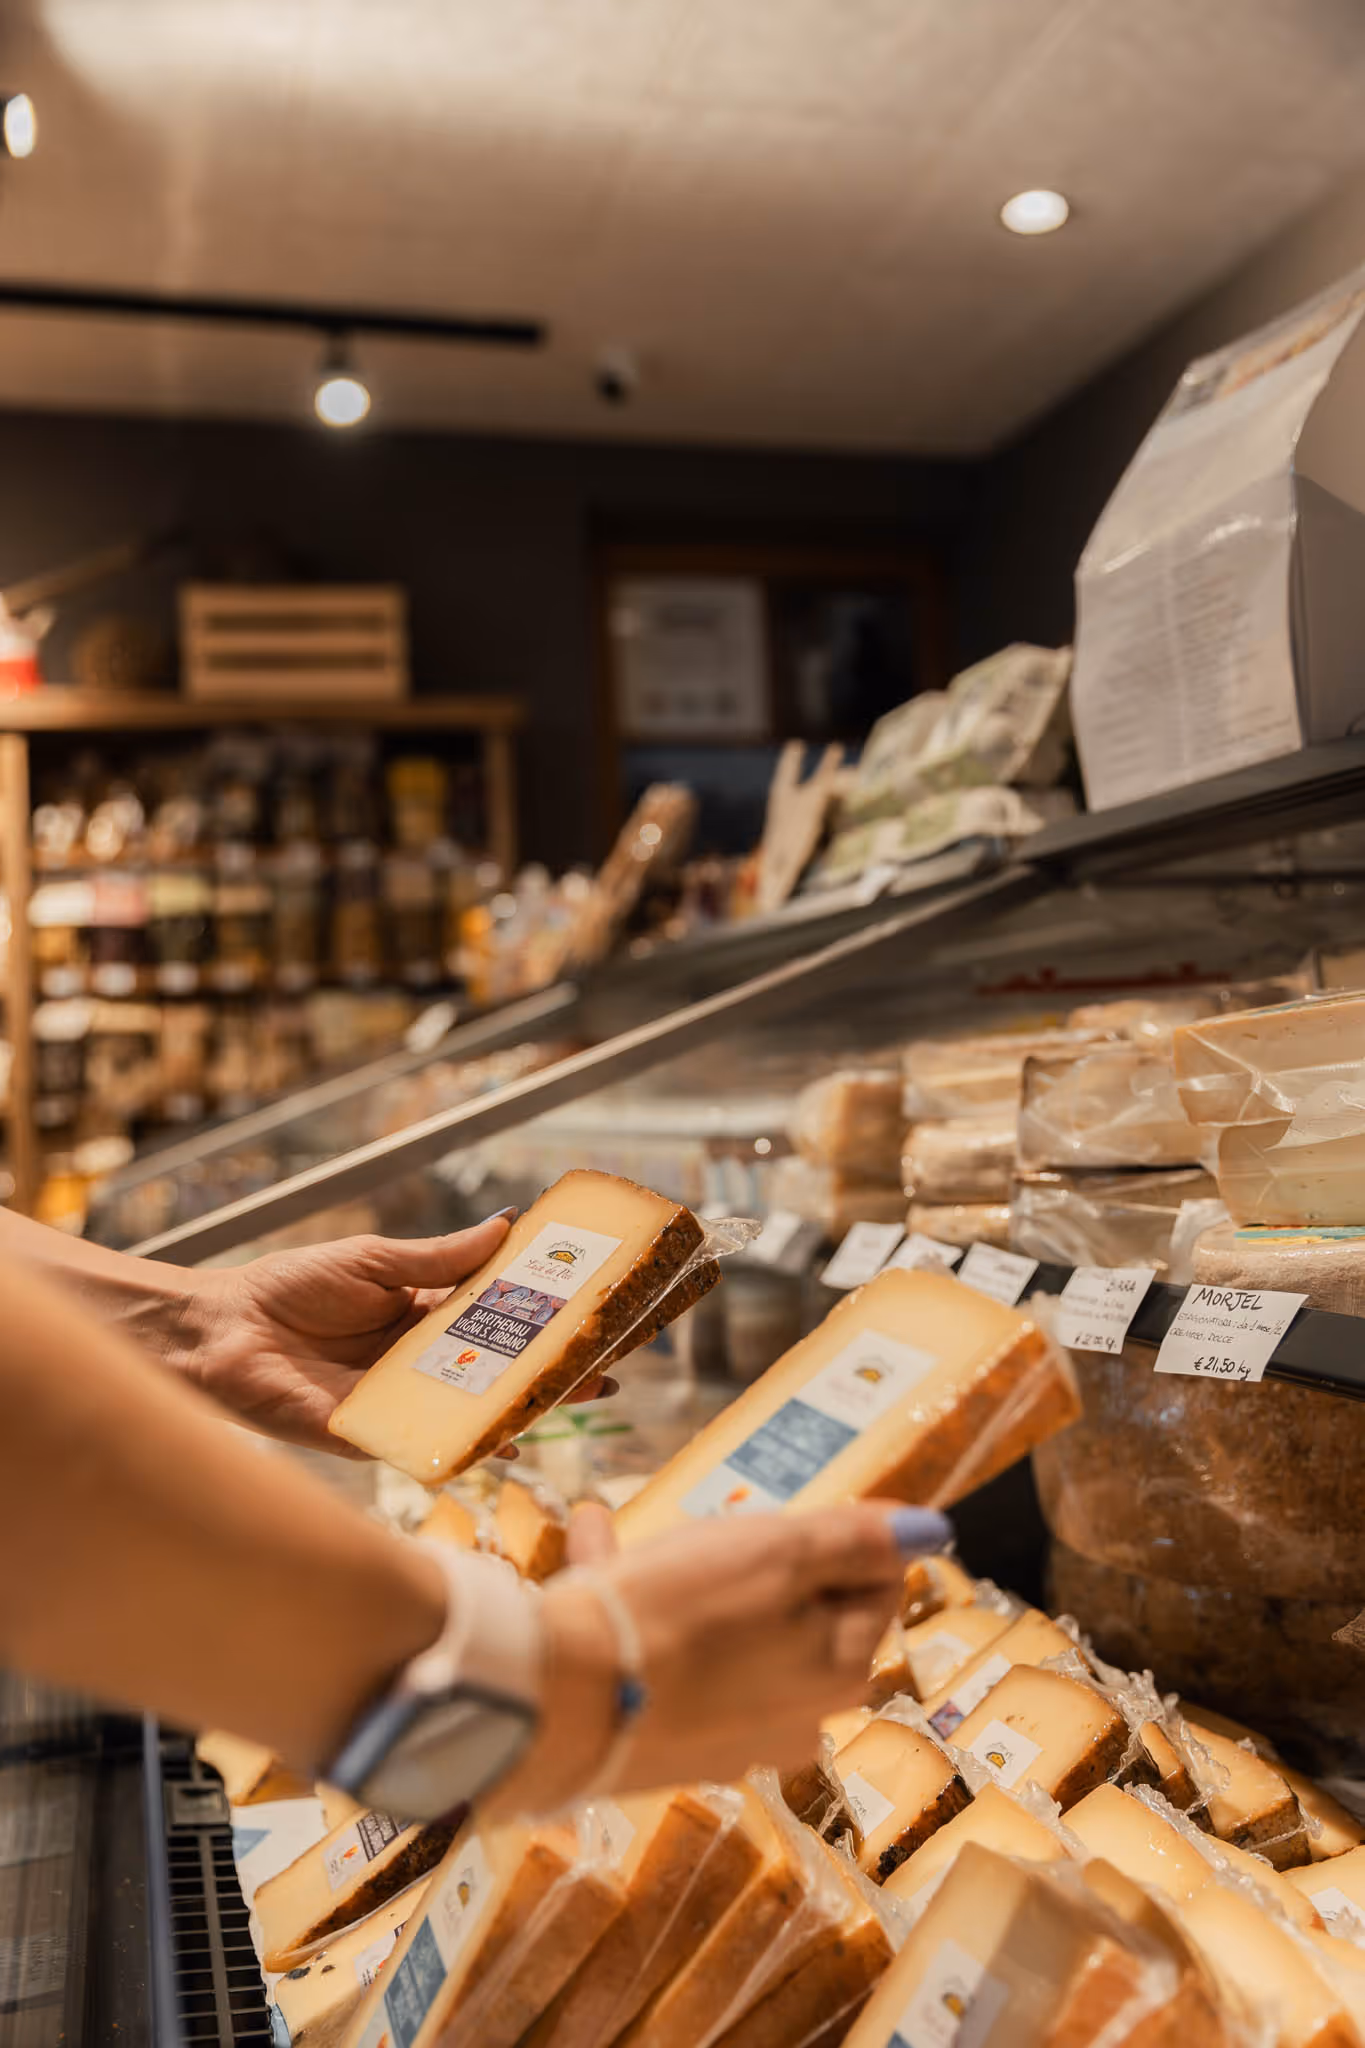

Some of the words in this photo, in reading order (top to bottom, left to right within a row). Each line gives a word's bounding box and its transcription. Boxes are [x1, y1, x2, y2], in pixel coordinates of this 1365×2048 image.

[1192, 1287, 1264, 1312] MORJEL
[456, 1317, 484, 1335] VIGNA
[480, 1327, 491, 1339] S.
[489, 1329, 527, 1350] URBANO
[471, 1309, 532, 1337] BARTHENAU
[1193, 1356, 1205, 1371] €
[1203, 1355, 1236, 1374] 21,50
[1237, 1359, 1252, 1382] kg
